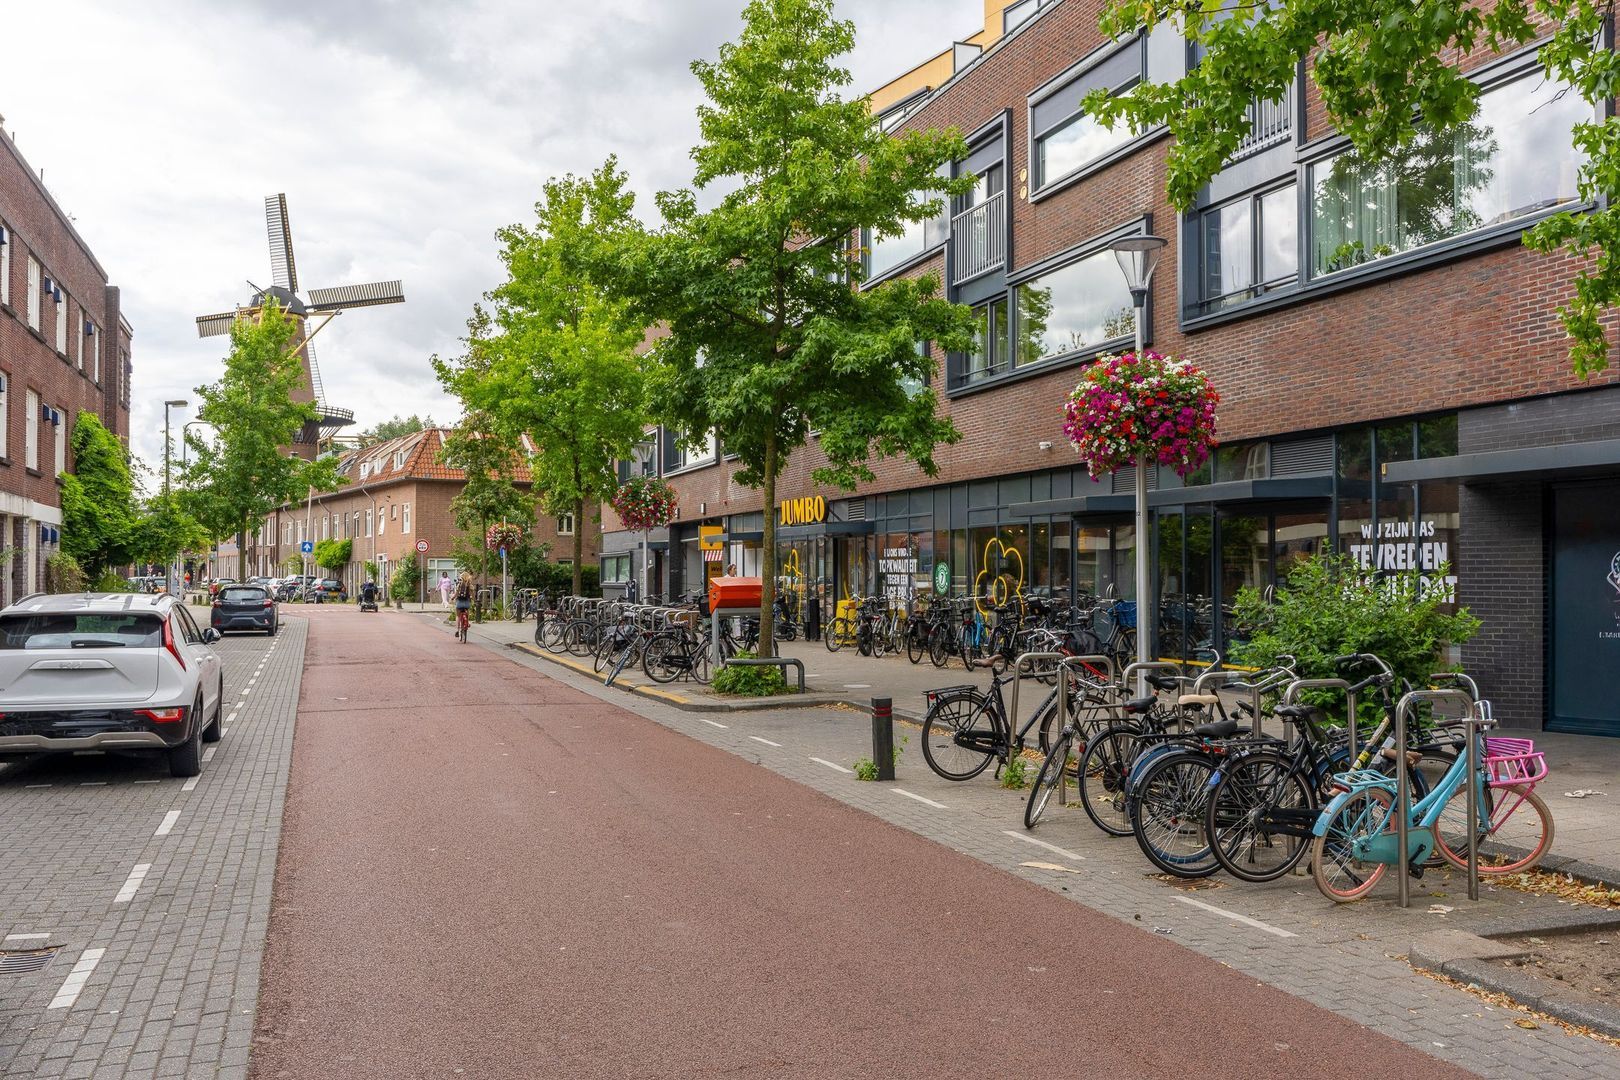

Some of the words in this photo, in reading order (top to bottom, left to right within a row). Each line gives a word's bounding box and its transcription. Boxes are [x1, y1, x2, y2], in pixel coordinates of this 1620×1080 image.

[780, 495, 825, 526] JUMBO
[1361, 523, 1381, 539] WIJ
[1384, 521, 1409, 538] ZIJN
[879, 559, 917, 573] TOPKWALITEIT
[1350, 542, 1448, 570] TEVREDEN
